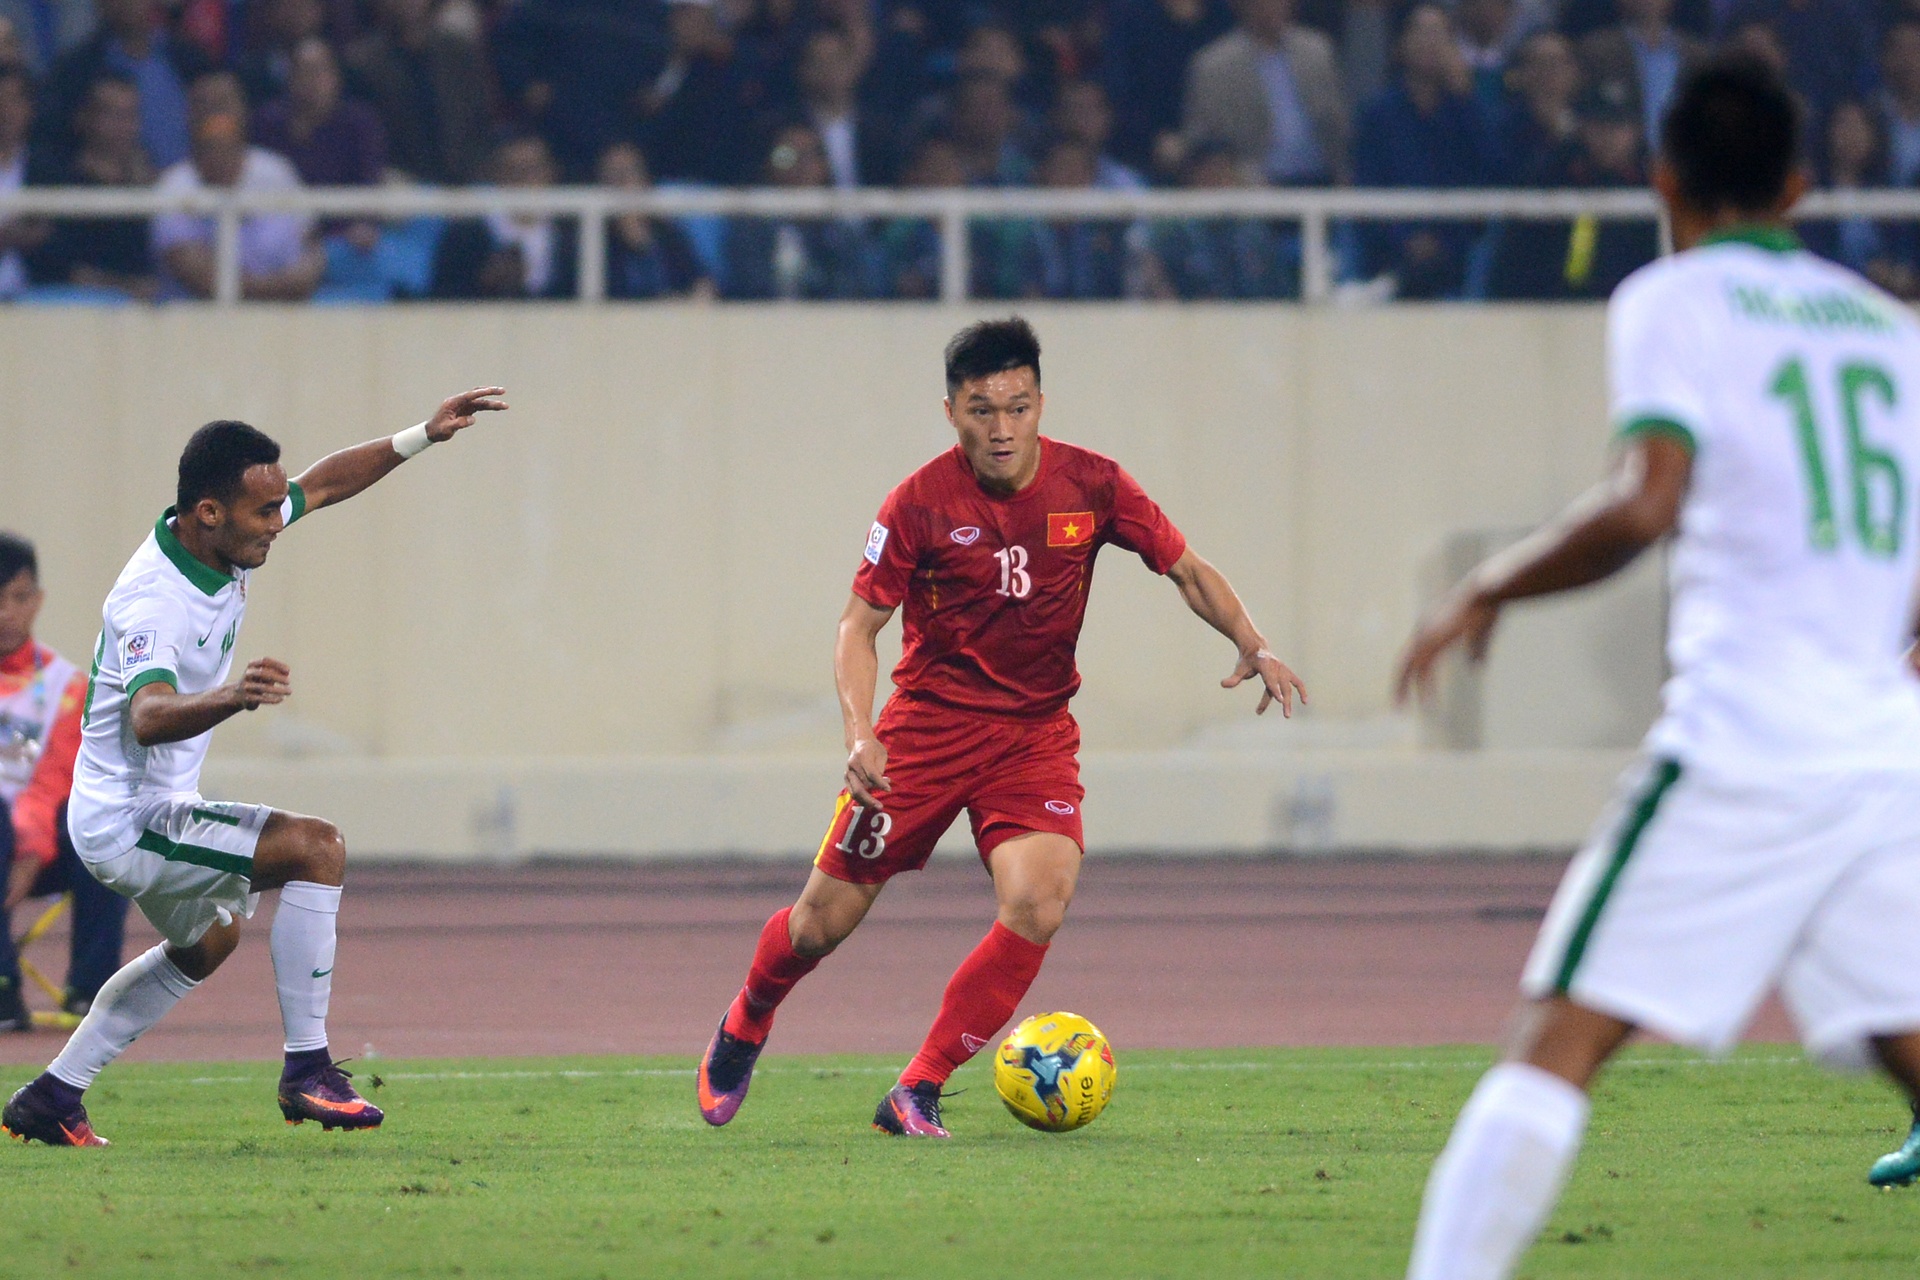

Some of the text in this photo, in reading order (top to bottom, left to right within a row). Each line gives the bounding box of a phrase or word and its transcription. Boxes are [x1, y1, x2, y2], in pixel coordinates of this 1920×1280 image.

[1769, 350, 1903, 558] 16
[993, 545, 1031, 598] 13
[835, 805, 892, 859] 13
